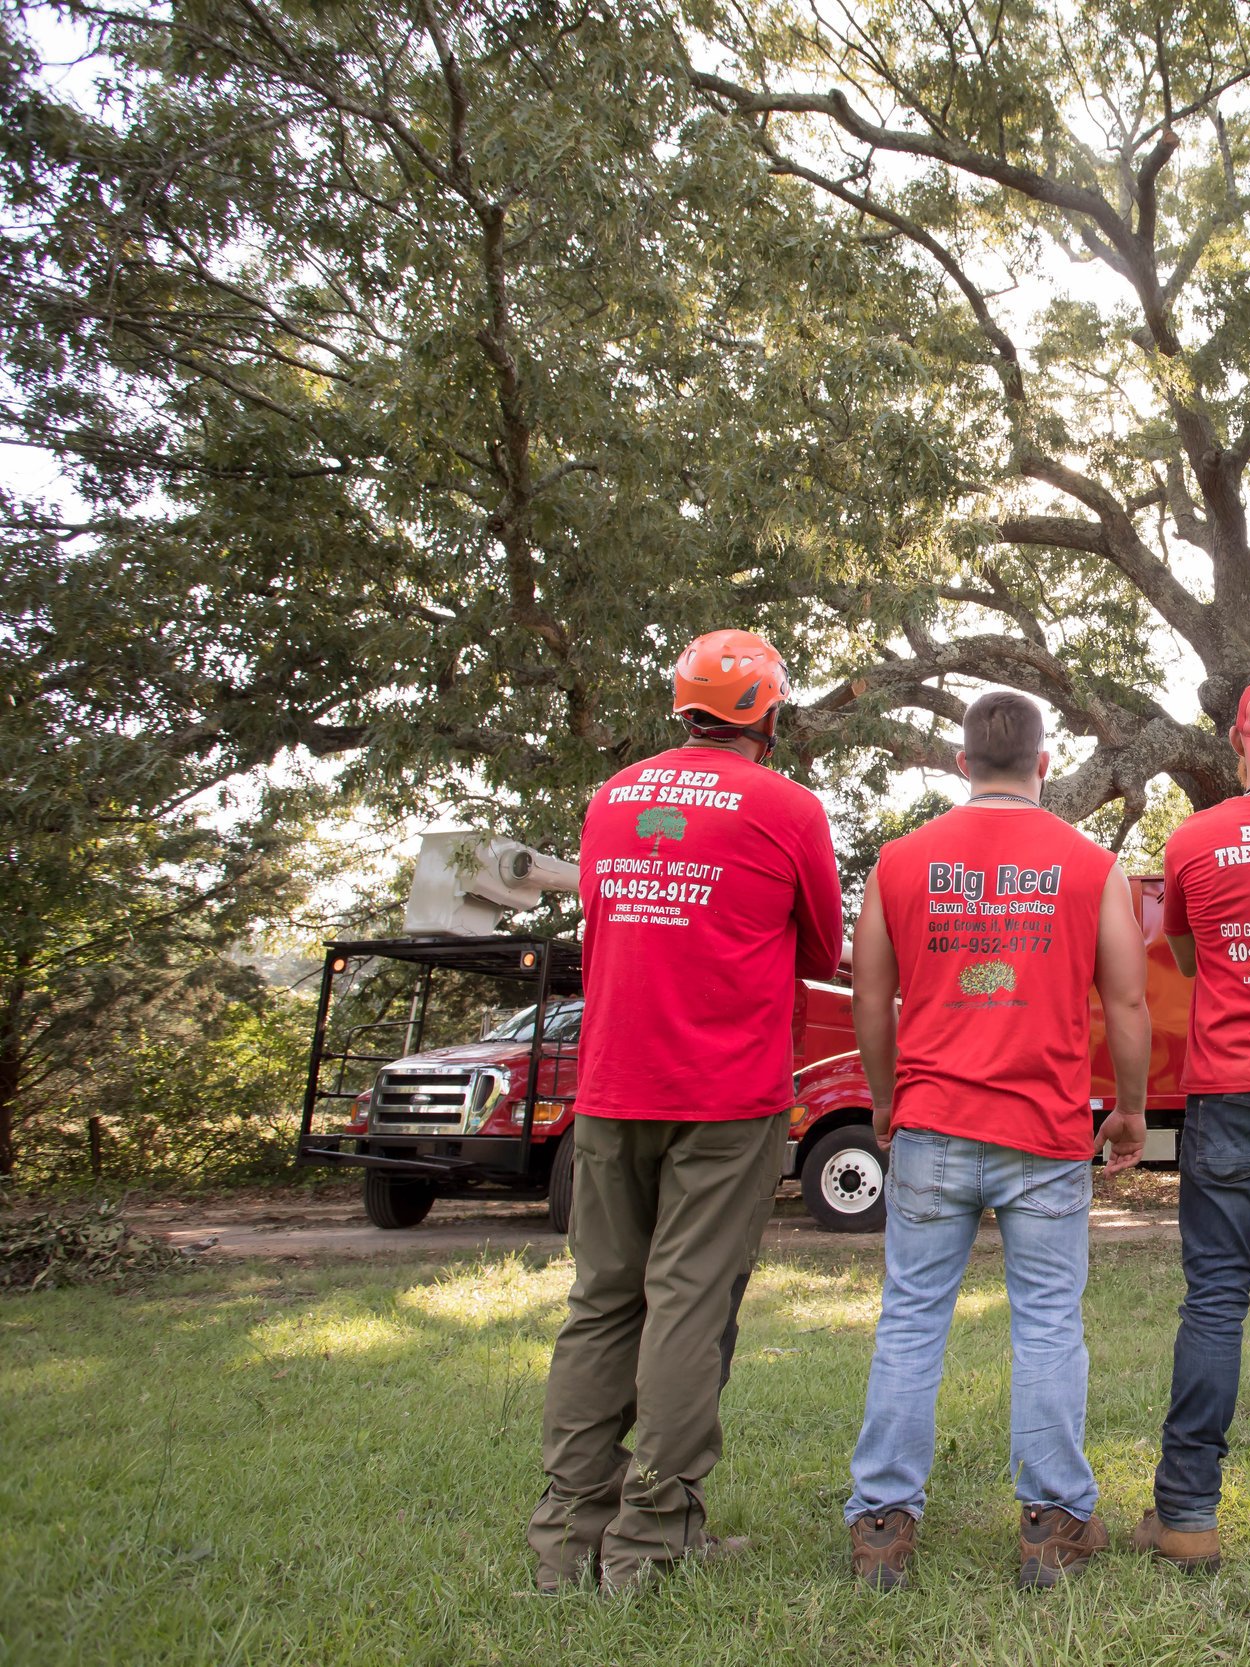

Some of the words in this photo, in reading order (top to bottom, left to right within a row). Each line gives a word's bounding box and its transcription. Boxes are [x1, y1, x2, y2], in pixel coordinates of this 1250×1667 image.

[638, 769, 675, 784] BIG
[677, 770, 719, 788] RED
[608, 785, 656, 804] TREE
[656, 786, 743, 811] SERVICE
[596, 859, 612, 875] GOD
[614, 859, 651, 875] GROWS
[652, 860, 664, 877] IT,
[667, 861, 685, 877] WE
[686, 864, 711, 879] CUT
[712, 866, 723, 882] IT
[928, 862, 985, 902] Big
[996, 863, 1062, 896] Red
[615, 904, 632, 913] FREE
[633, 904, 681, 916] ESTIMATES
[929, 901, 963, 914] Lawn
[966, 901, 977, 914] &
[980, 902, 1007, 915] Tree
[1009, 901, 1054, 915] Service
[608, 914, 640, 924] LICENSED
[641, 915, 648, 924] &
[650, 915, 690, 926] INSURED
[928, 920, 950, 932] God
[954, 919, 987, 932] Grows
[1004, 919, 1020, 931] We
[1023, 920, 1040, 932] cut
[1044, 921, 1052, 933] it
[1220, 924, 1241, 938] GOD
[928, 936, 1052, 954] 404-952-9177
